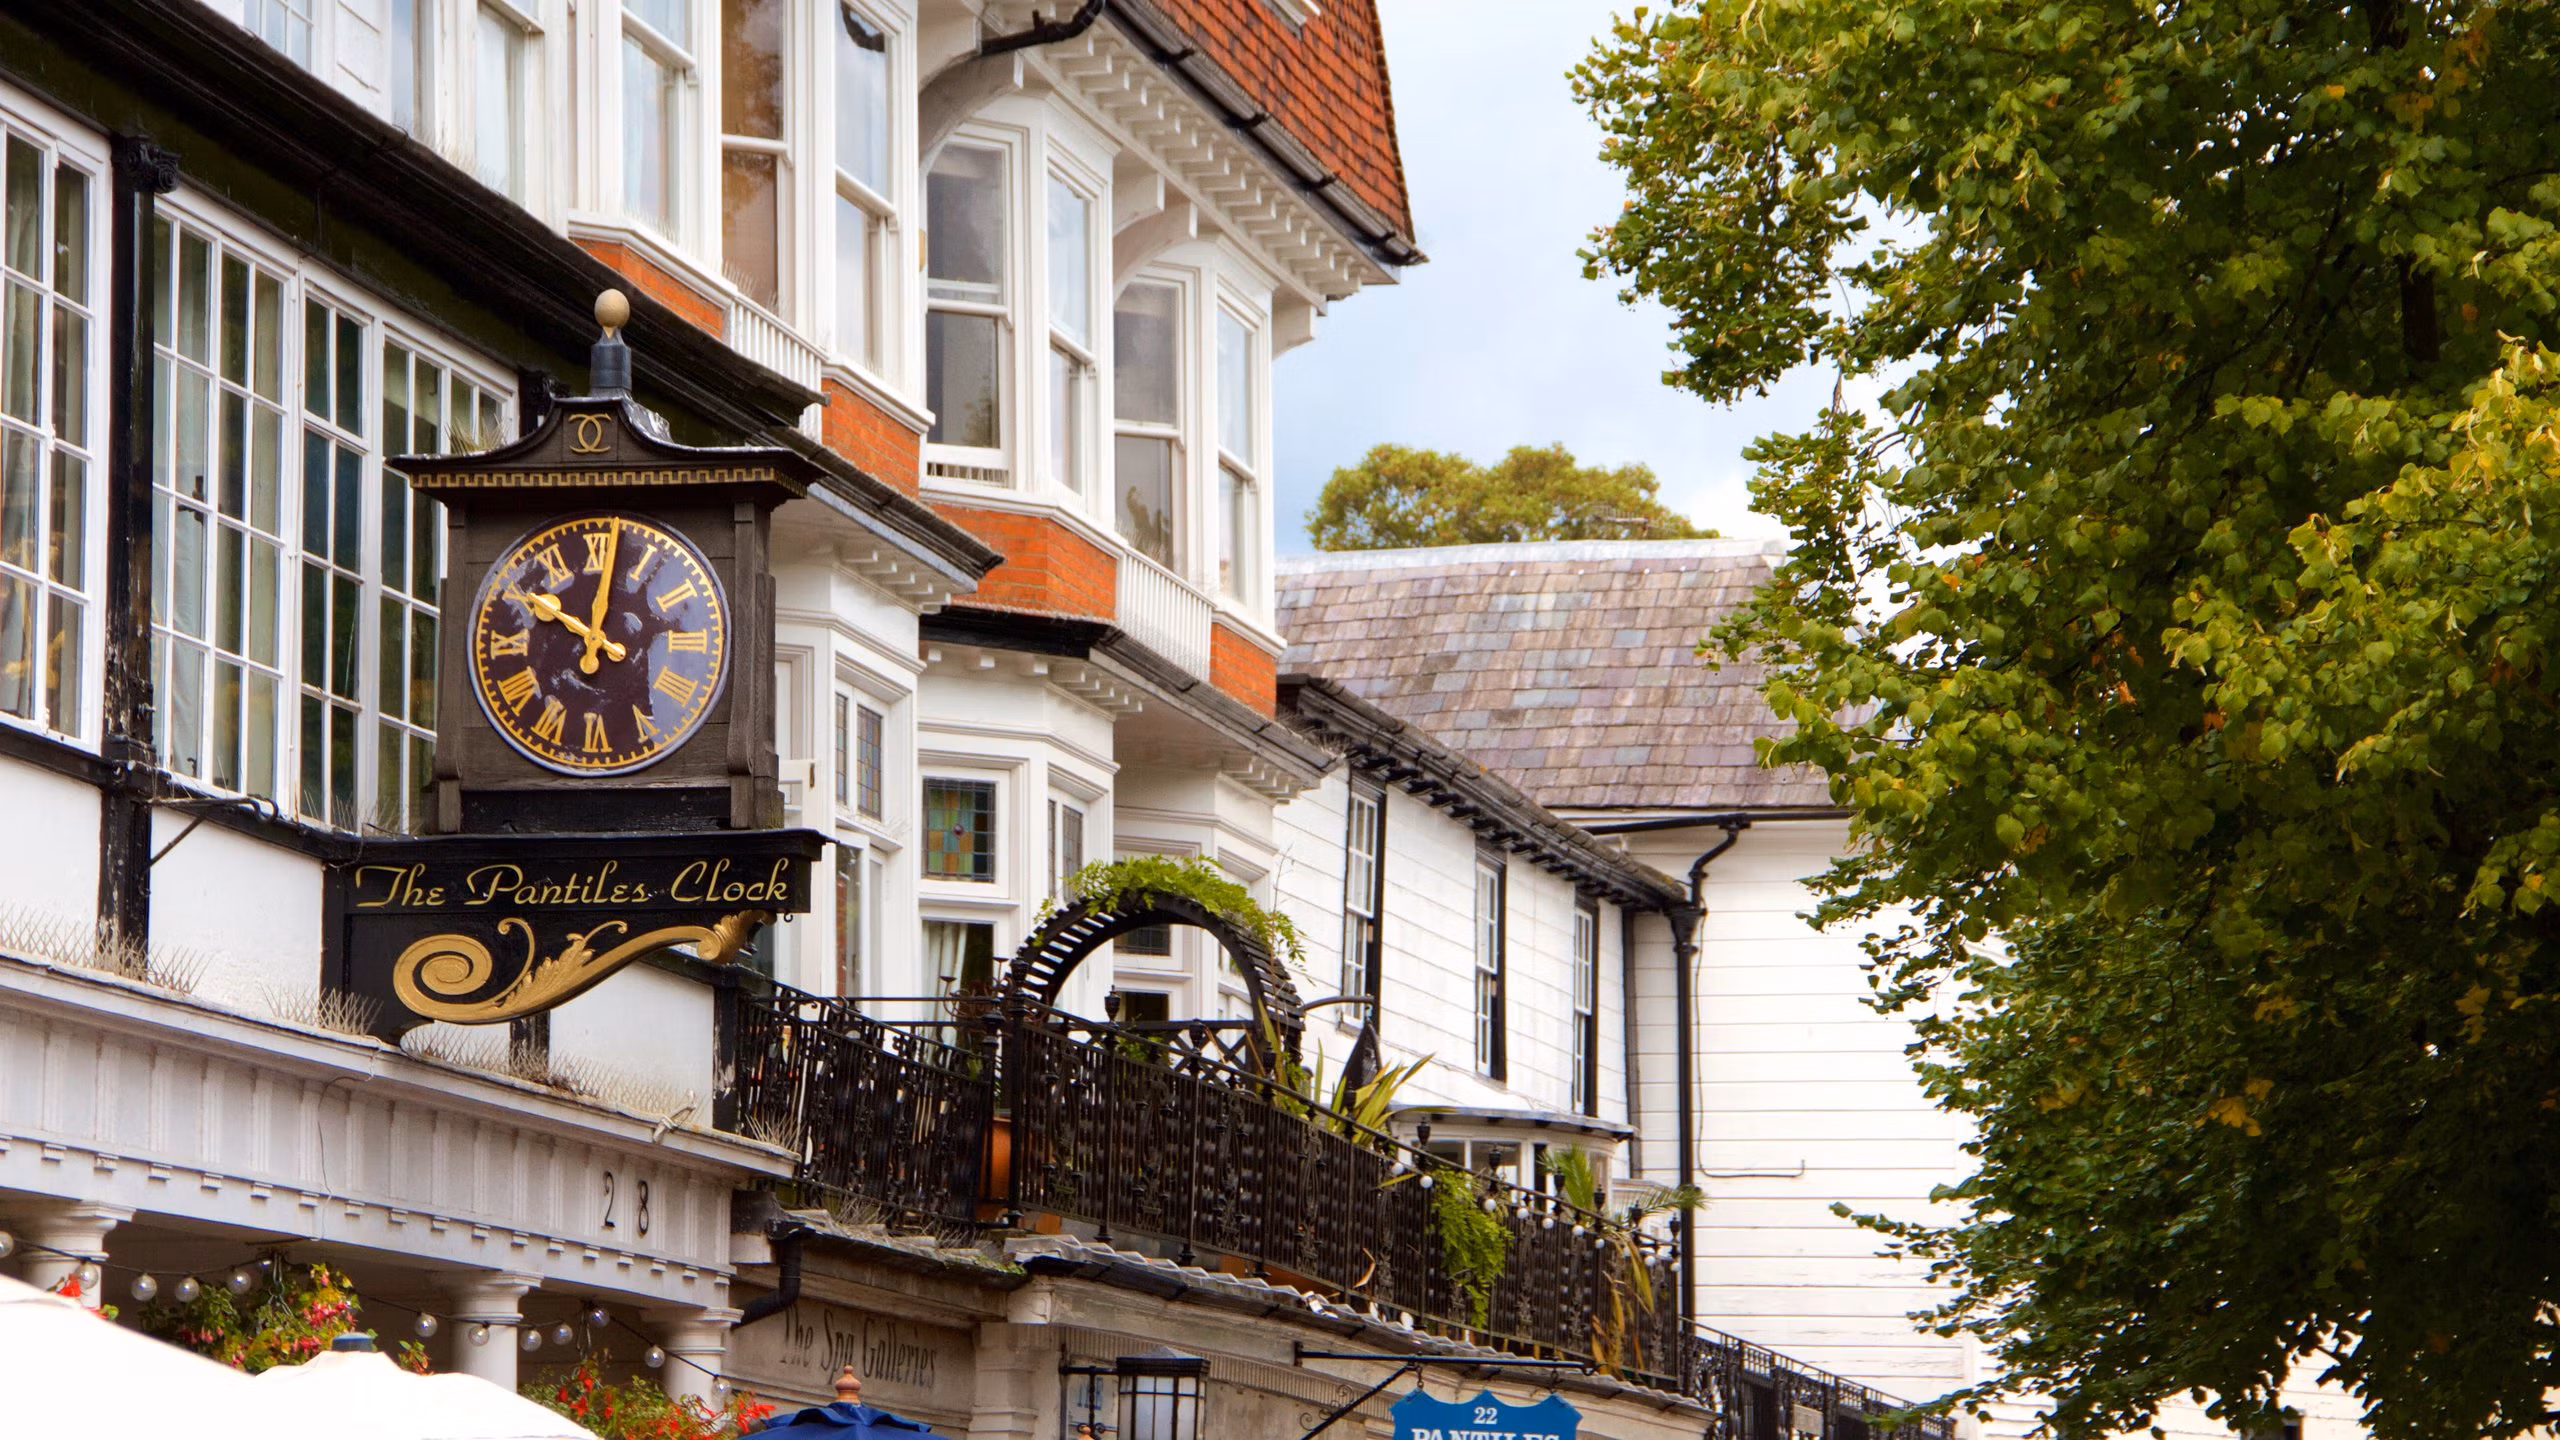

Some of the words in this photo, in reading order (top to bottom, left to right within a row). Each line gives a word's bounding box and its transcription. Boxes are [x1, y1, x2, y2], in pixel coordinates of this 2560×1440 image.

[536, 543, 574, 588] XI
[656, 578, 697, 612] II
[668, 629, 708, 654] III
[355, 862, 445, 907] The
[464, 859, 649, 906] Pantiles
[671, 857, 788, 902] Clock
[781, 1304, 814, 1368] The
[820, 1307, 856, 1386] Spa
[862, 1317, 938, 1389] Galleries
[1473, 1406, 1498, 1425] 22
